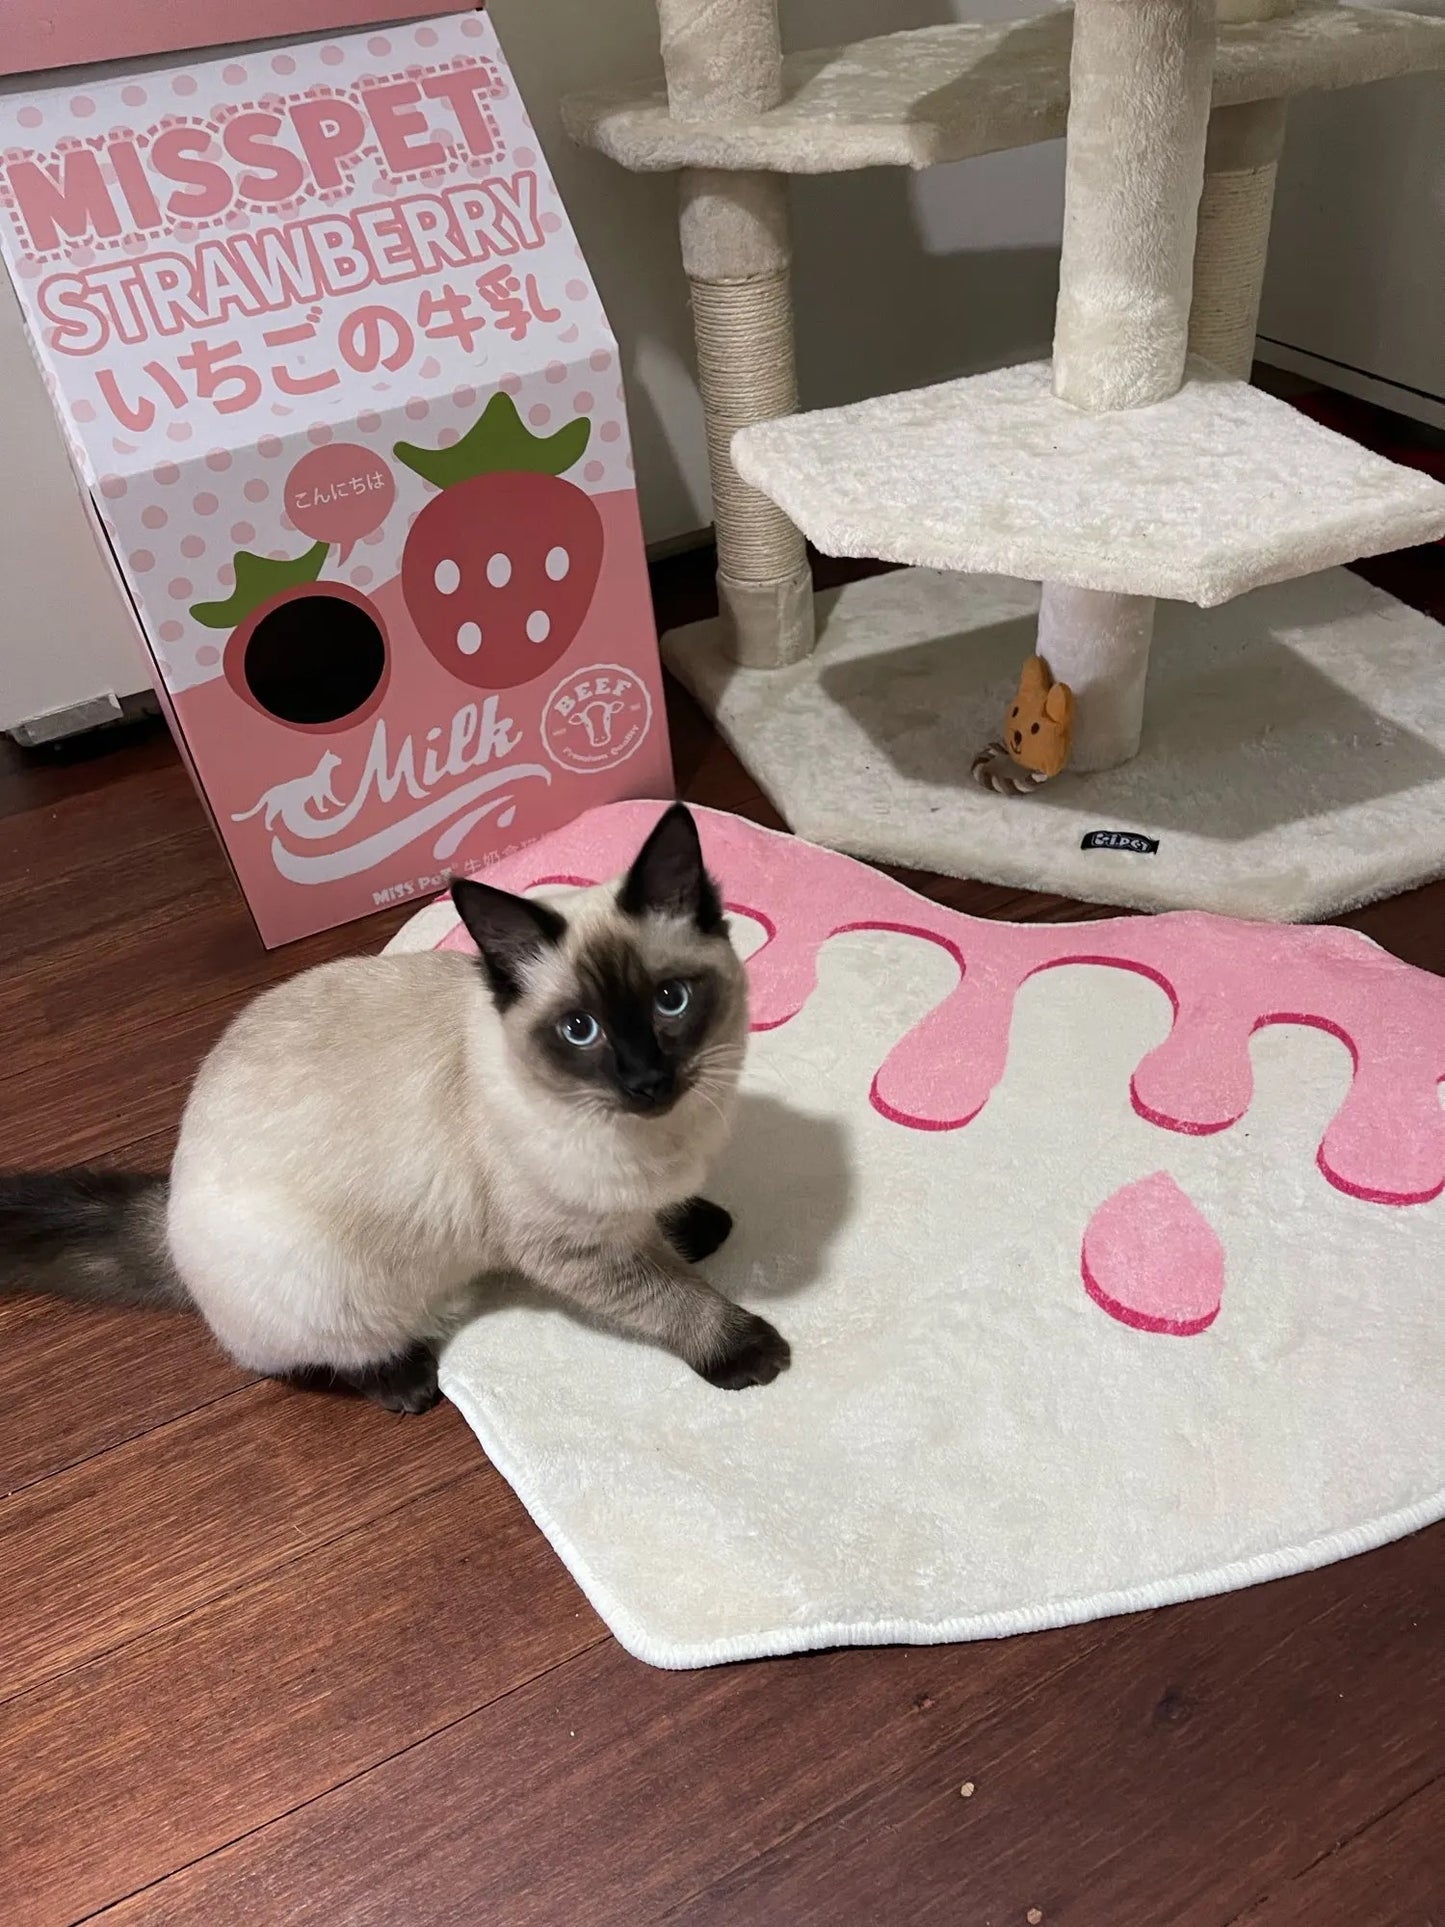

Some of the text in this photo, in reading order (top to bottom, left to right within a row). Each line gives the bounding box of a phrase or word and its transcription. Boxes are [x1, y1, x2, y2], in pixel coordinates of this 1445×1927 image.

[6, 66, 496, 253] MISSPET
[38, 169, 546, 356] STRAWBERRY
[95, 264, 561, 433] いちごの牛乳
[294, 471, 385, 509] こんにちは
[300, 695, 523, 830] Milk
[554, 677, 632, 717] BEEF
